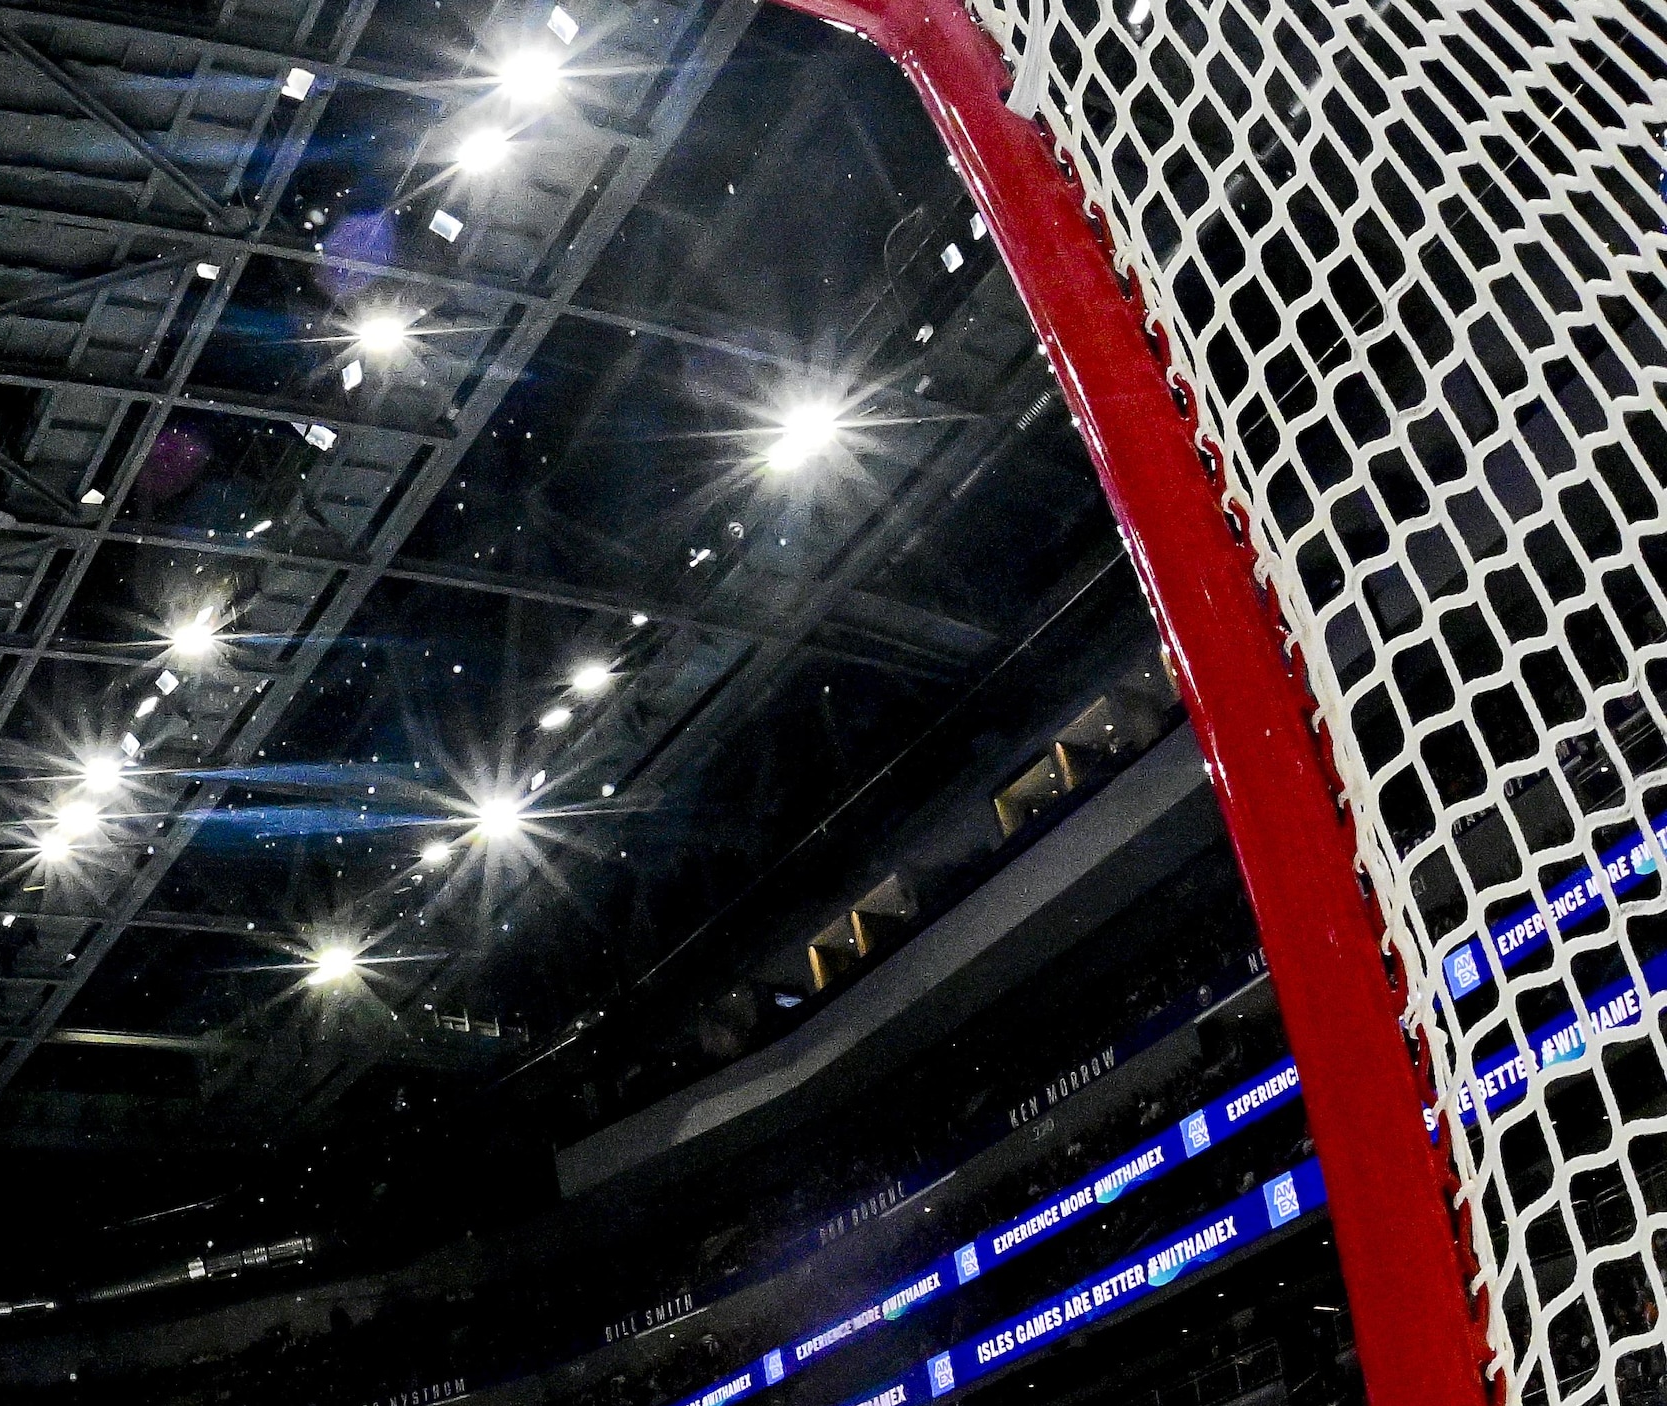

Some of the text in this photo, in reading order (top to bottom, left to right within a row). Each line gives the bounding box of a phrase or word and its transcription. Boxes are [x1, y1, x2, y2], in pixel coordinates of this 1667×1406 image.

[993, 1146, 1165, 1255] EXPERIENCE MORE #WITHAMEX
[977, 1215, 1238, 1364] ISLES GAMES ARE BETTER #WITHAMEX
